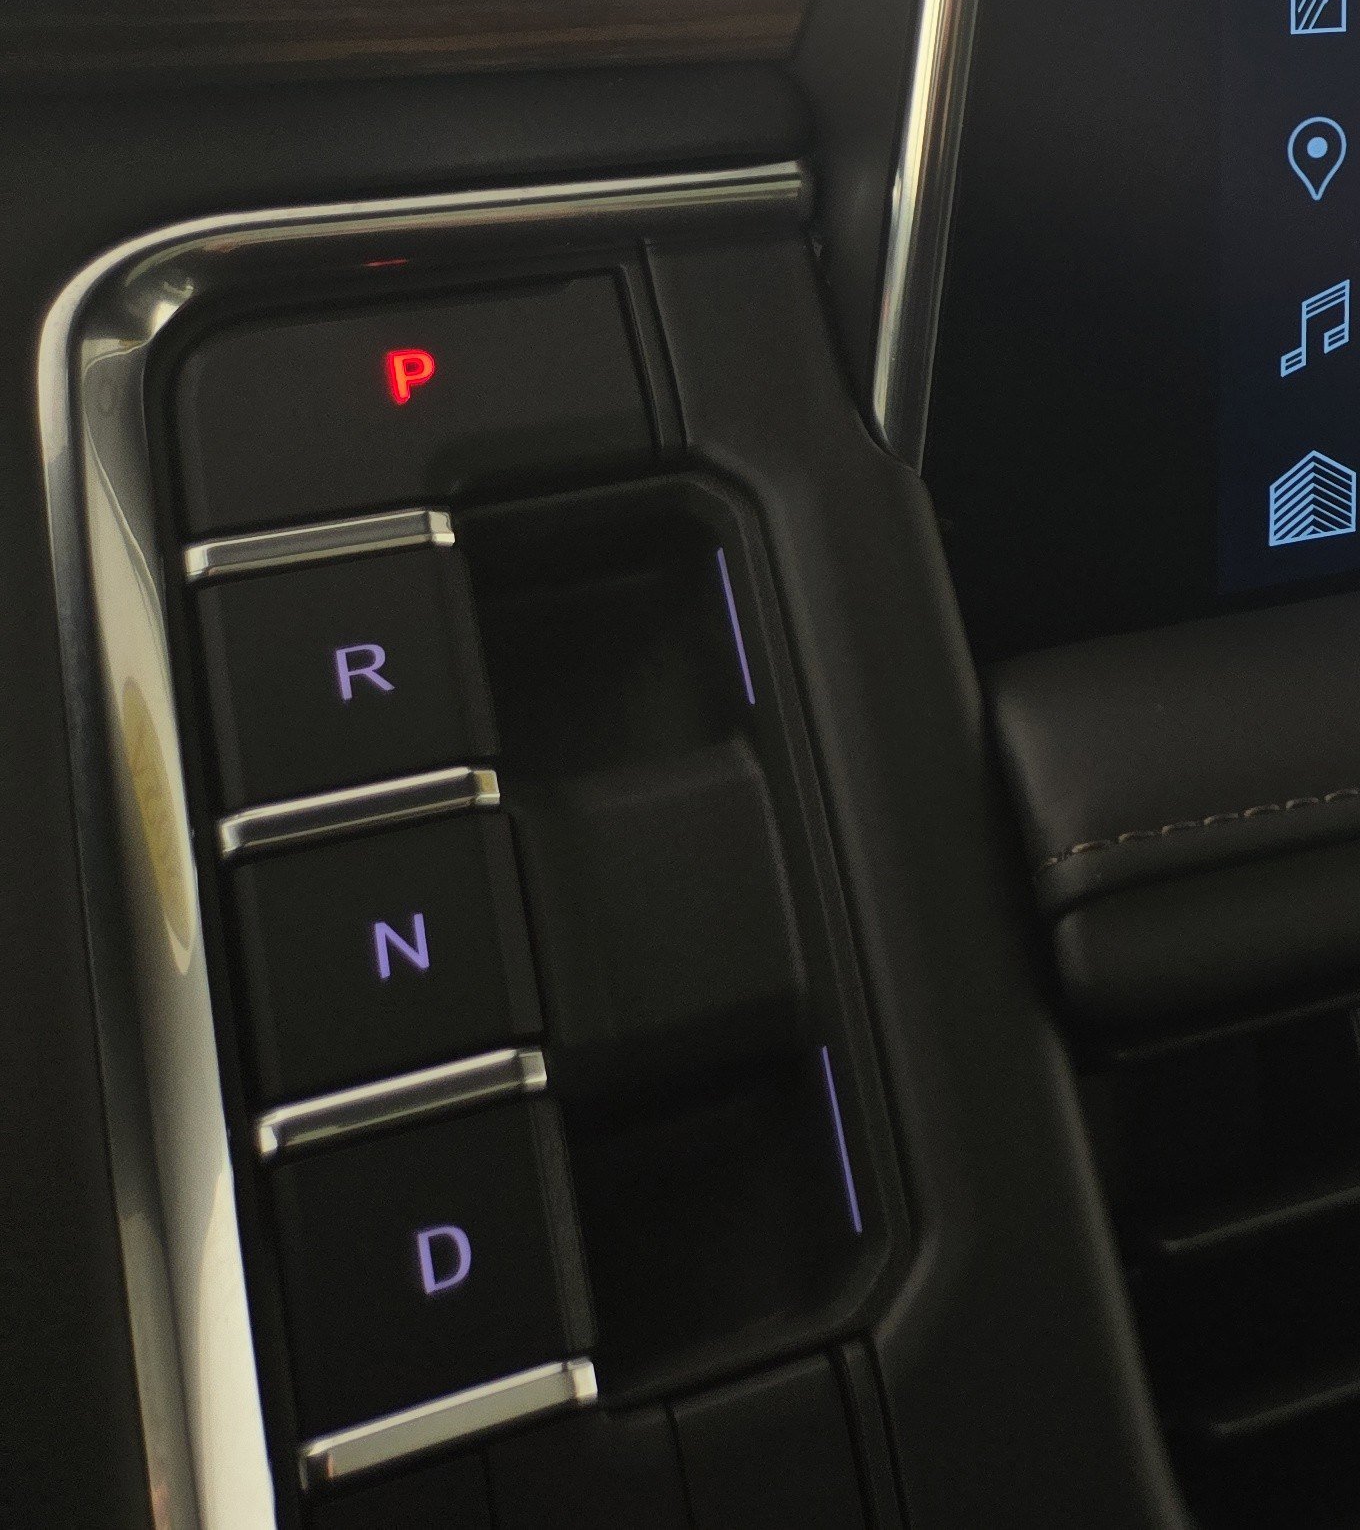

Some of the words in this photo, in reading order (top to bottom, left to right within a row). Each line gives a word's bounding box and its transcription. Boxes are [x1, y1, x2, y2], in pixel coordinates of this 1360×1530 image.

[383, 348, 436, 404] P
[332, 642, 396, 701] R
[372, 912, 430, 980] N
[415, 1223, 473, 1295] D
